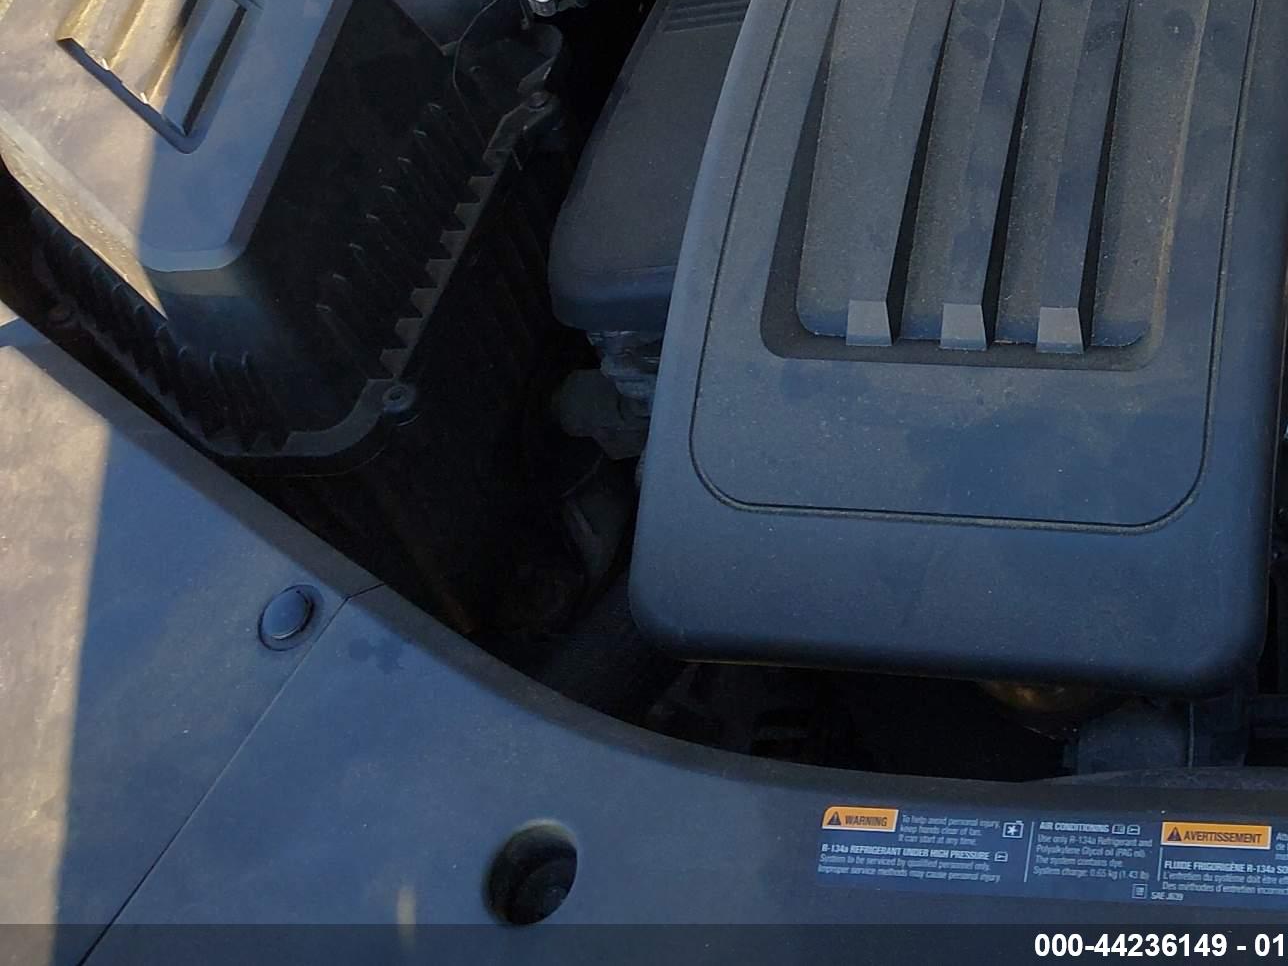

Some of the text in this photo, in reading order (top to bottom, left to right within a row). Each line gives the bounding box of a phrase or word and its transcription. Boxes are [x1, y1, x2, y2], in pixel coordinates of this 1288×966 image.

[845, 815, 887, 827] WARNING
[1040, 822, 1054, 830] AIR
[1184, 831, 1262, 843] AVERTISSEMENT
[850, 845, 901, 855] REFRIGERANT
[902, 848, 929, 857] UNDER
[950, 851, 990, 860] PRESSURE
[1164, 861, 1193, 870] FLUIDE
